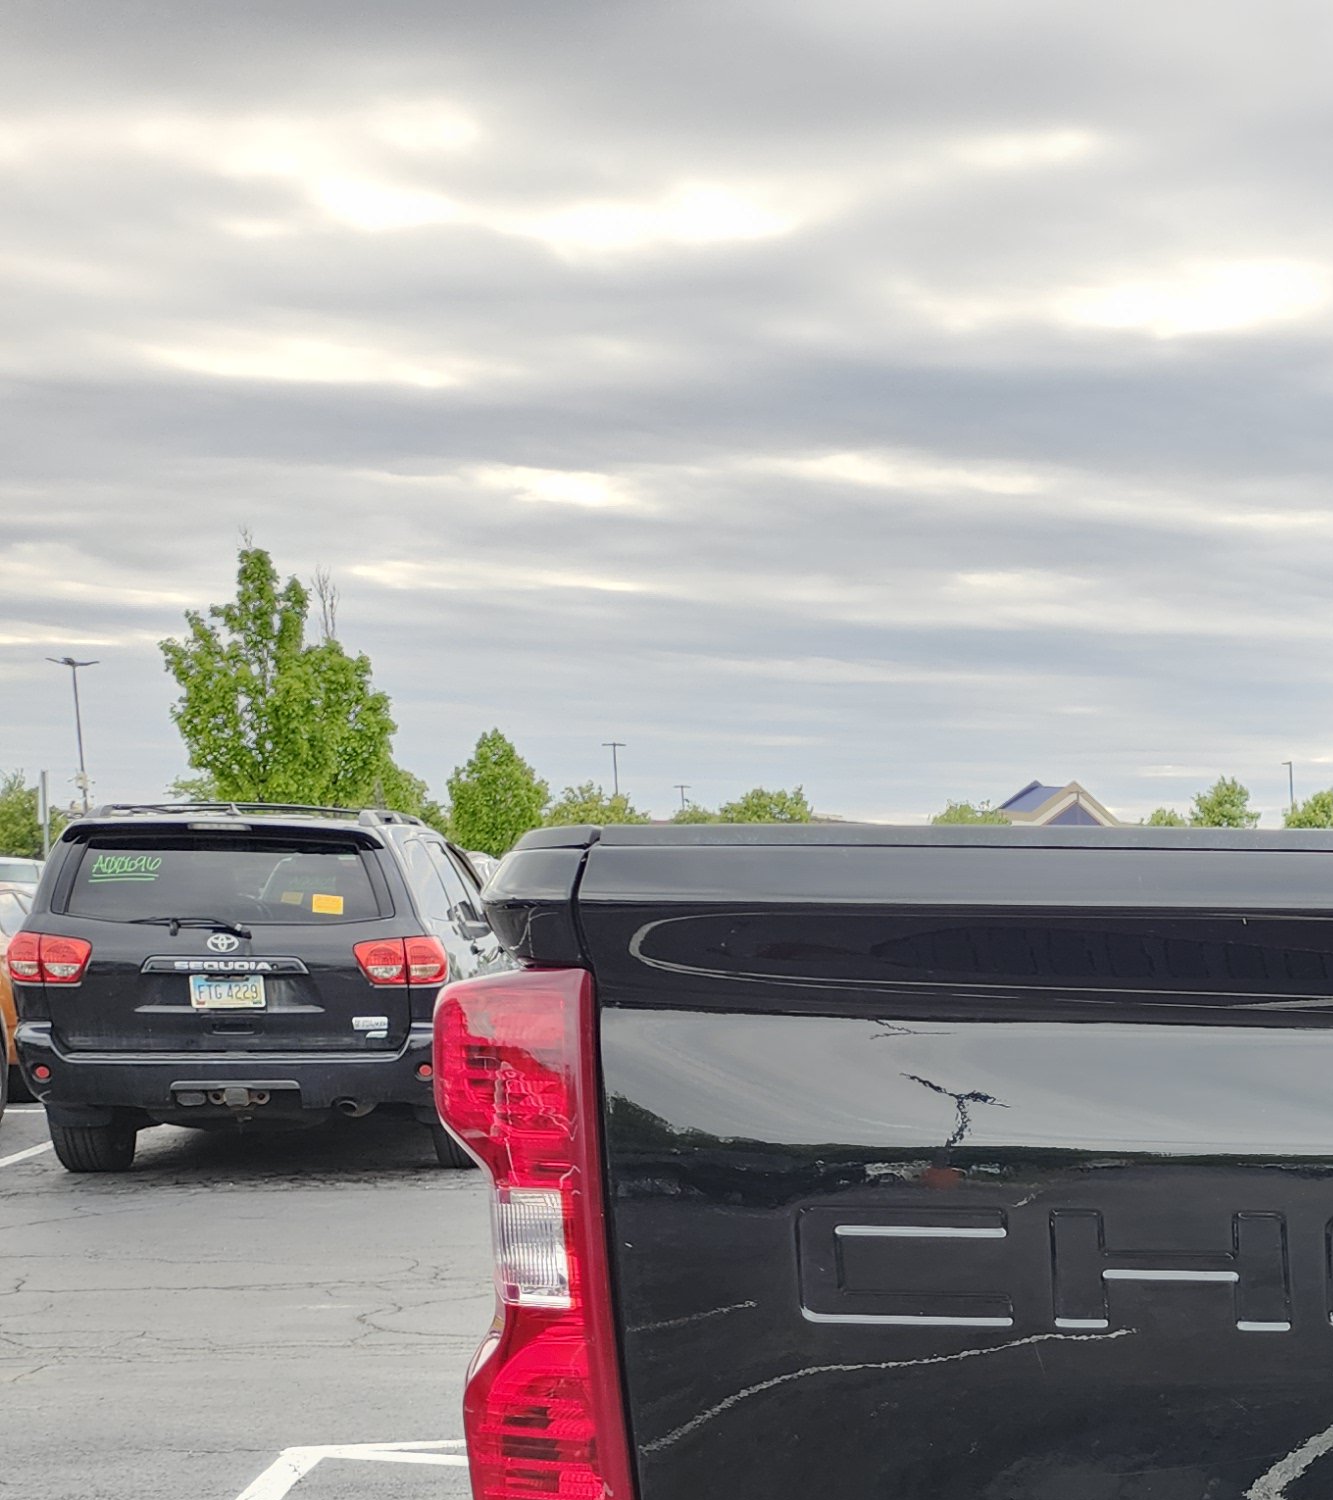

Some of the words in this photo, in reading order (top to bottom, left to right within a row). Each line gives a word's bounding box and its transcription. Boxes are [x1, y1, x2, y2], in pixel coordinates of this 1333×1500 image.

[174, 961, 272, 971] SEQUOIA
[197, 984, 222, 1000] FTG
[226, 984, 259, 1000] 4229
